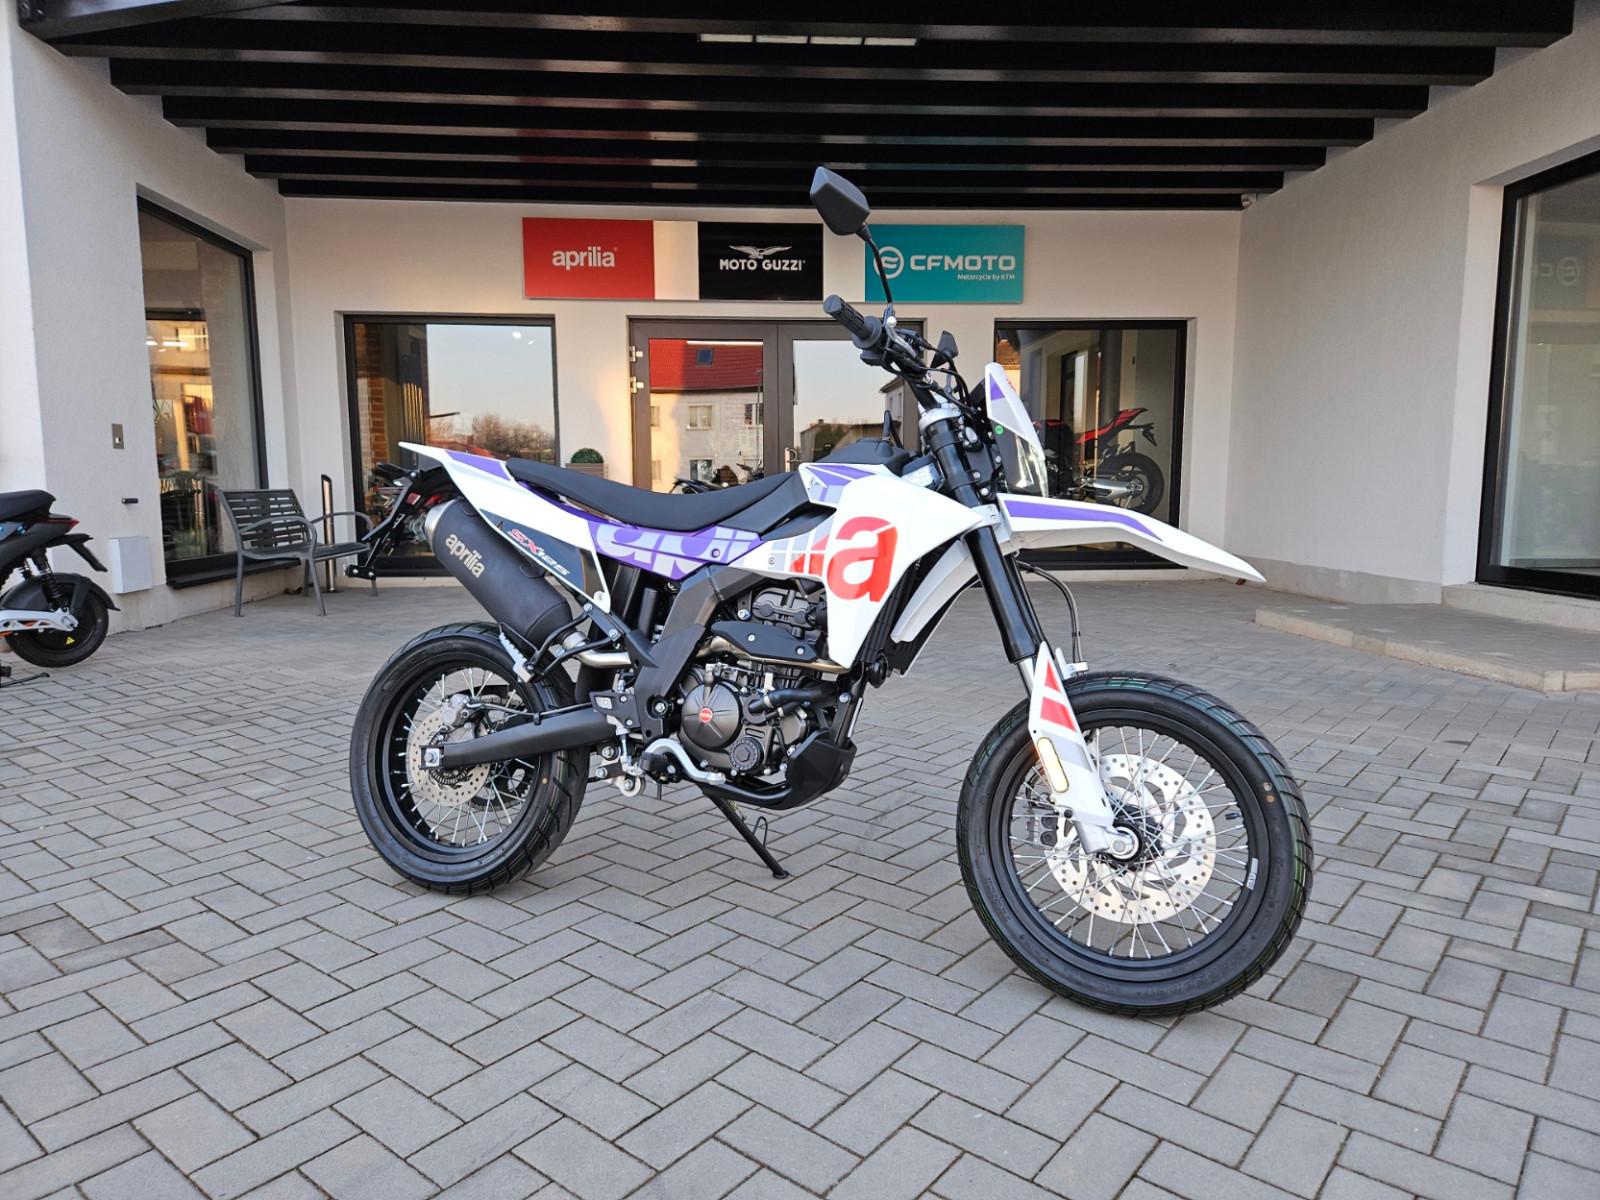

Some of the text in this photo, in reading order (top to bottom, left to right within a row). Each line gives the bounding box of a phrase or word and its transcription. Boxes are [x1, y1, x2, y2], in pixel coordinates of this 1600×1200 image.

[551, 246, 616, 271] aprilia
[719, 258, 802, 271] MOTO GUZZI
[909, 254, 1016, 271] CFMOTO
[957, 273, 991, 281] Motorcycle
[992, 273, 1000, 281] by
[445, 534, 485, 578] aprilia
